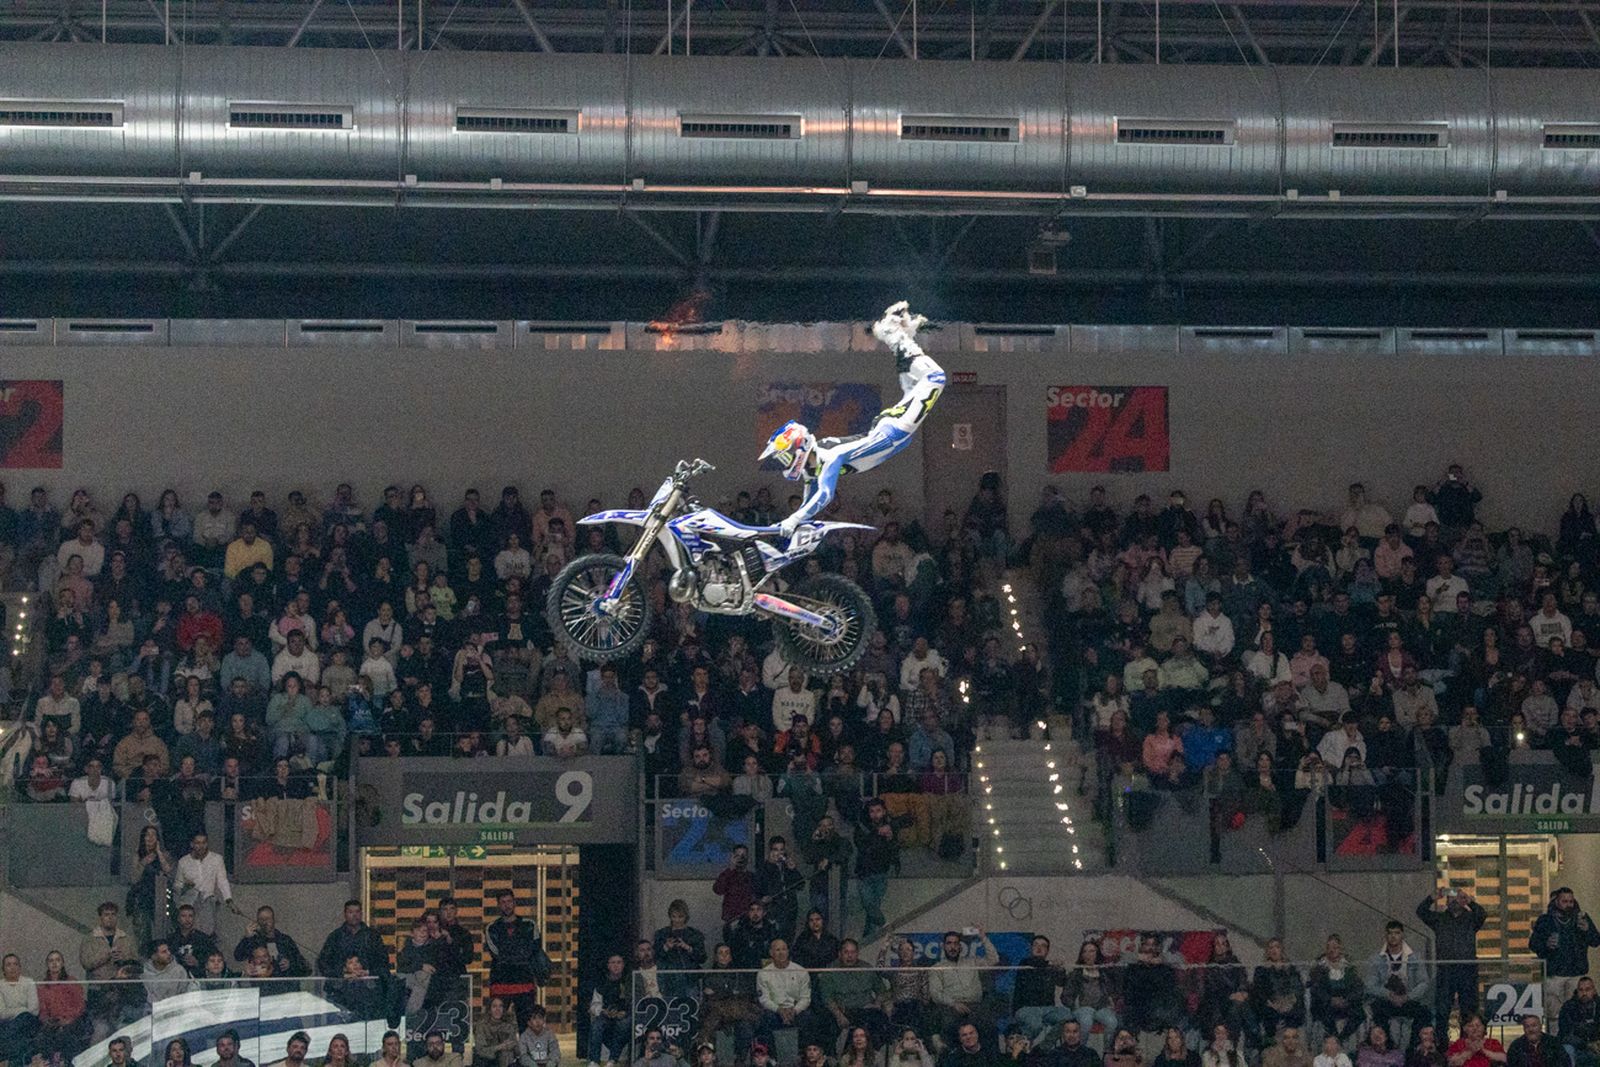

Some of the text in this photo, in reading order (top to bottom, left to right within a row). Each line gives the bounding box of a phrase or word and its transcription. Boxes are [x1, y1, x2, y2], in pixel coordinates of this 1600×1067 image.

[1047, 387, 1124, 408] Sector
[1047, 386, 1168, 473] 24
[402, 770, 593, 824] Salida 9
[1463, 783, 1585, 815] Salida
[1537, 820, 1569, 831] SALIDA
[480, 830, 515, 841] SALIDA
[1486, 983, 1544, 1025] 24
[1492, 1012, 1523, 1024] ecto
[405, 1028, 453, 1042] Secr
[635, 1023, 682, 1038] Stor
